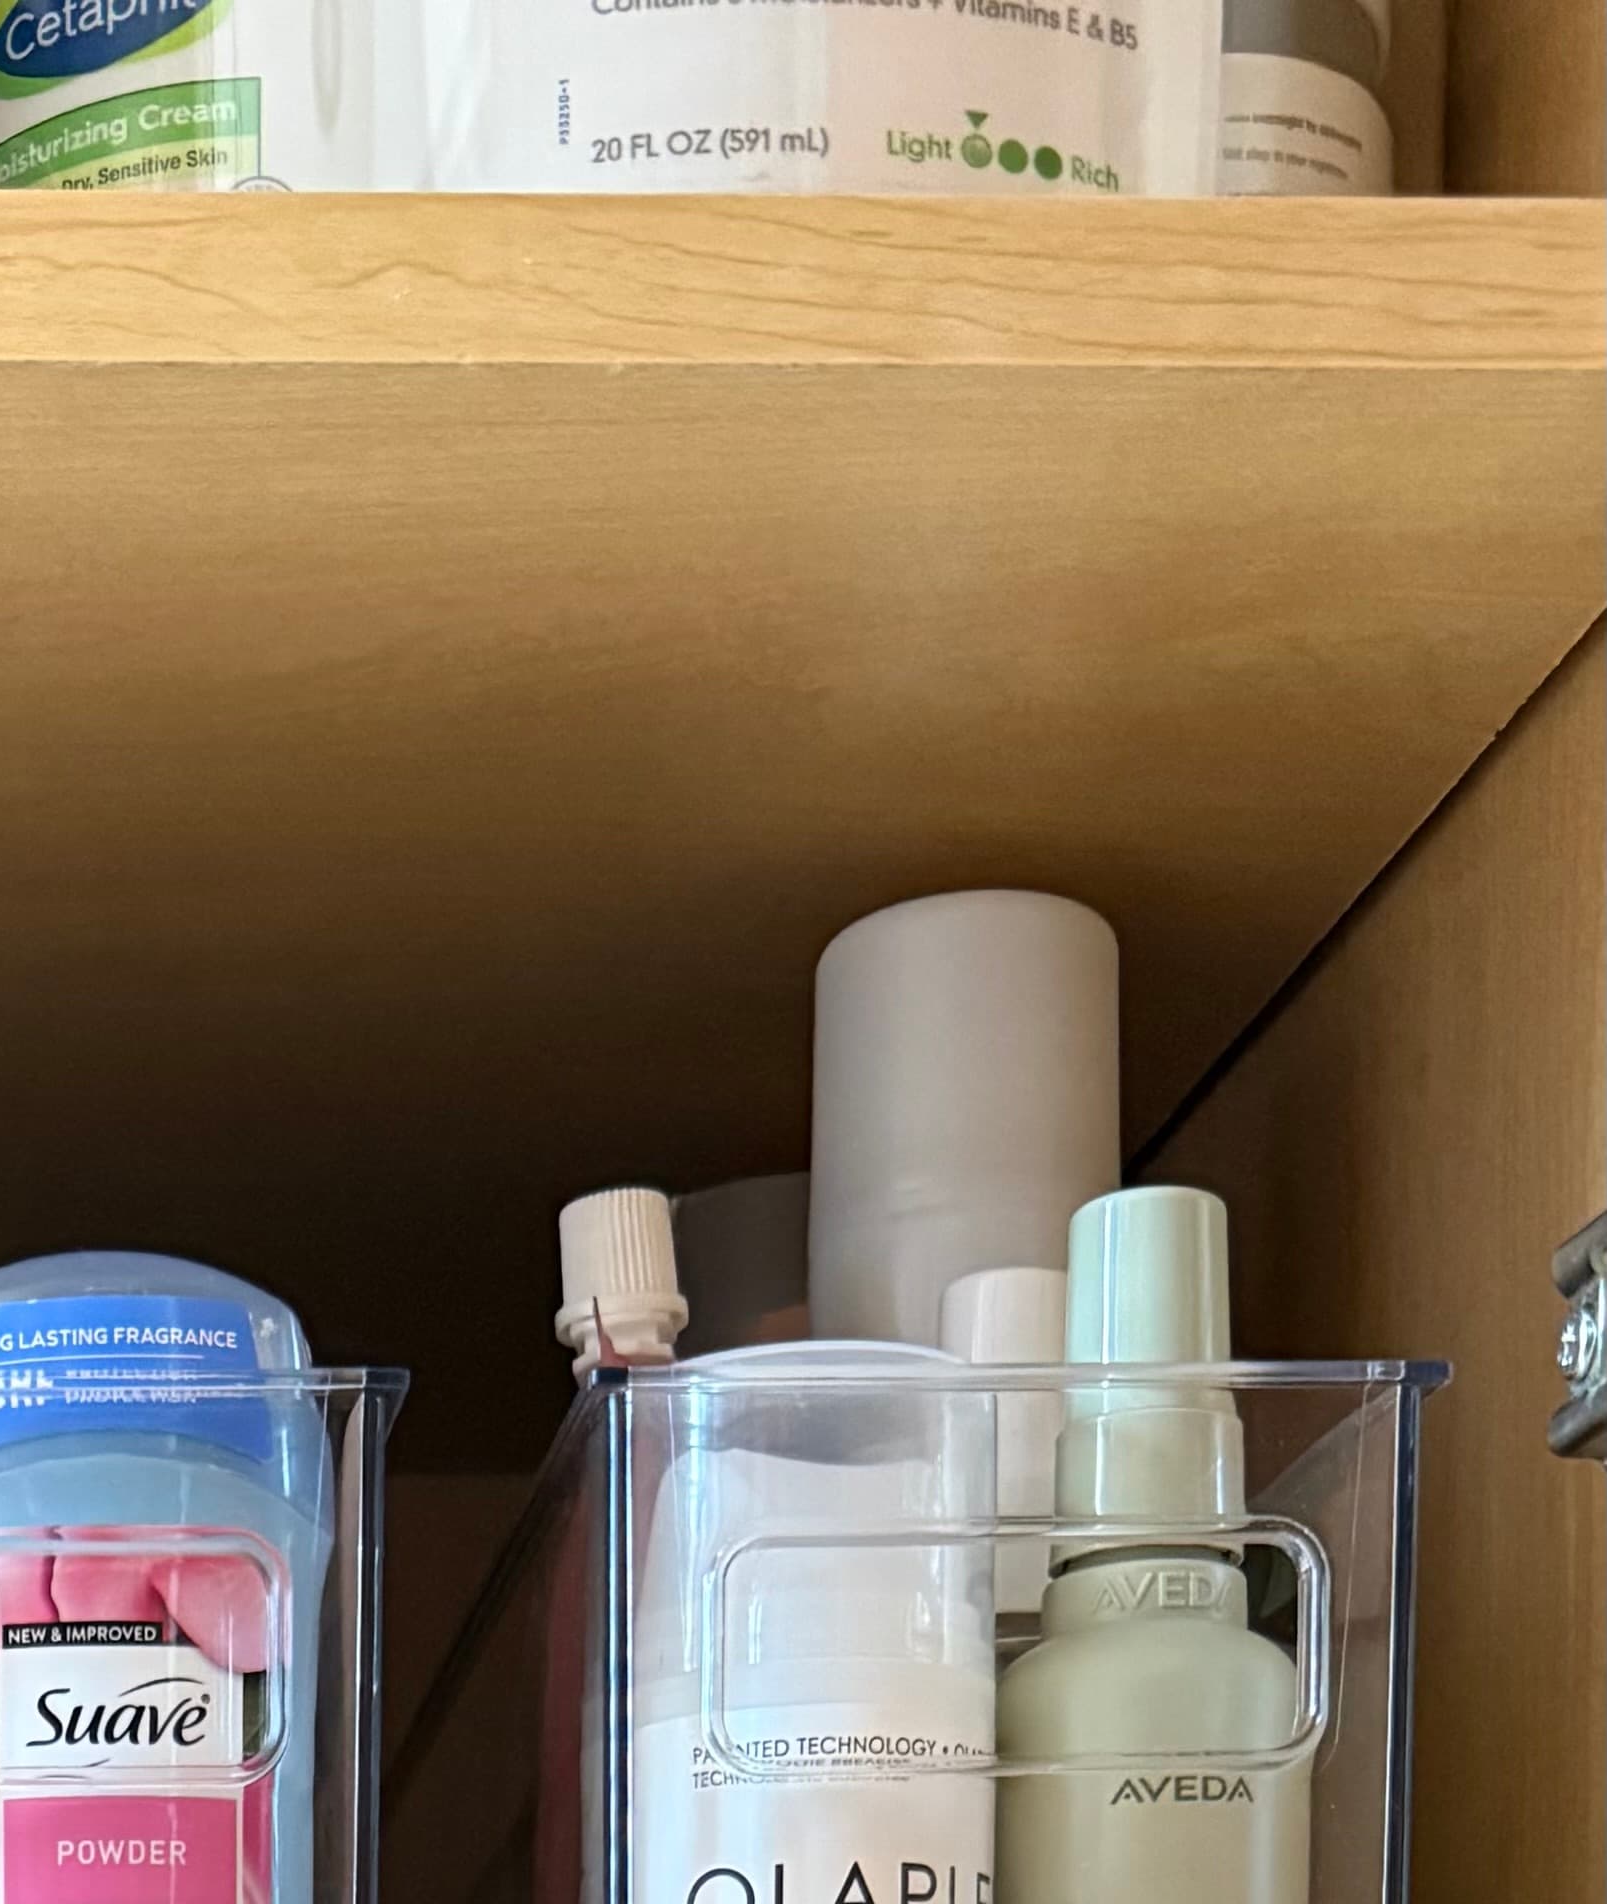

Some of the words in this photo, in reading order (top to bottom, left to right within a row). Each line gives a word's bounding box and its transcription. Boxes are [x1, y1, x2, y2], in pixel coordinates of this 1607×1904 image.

[5, 0, 196, 61] Cetap
[1068, 11, 1081, 36] E
[1087, 14, 1105, 44] &
[1110, 19, 1139, 51] B5
[139, 100, 236, 132] Cream
[591, 139, 622, 163] 20
[630, 133, 658, 159] FL
[667, 129, 712, 156] OZ
[720, 128, 771, 159] (591
[780, 129, 829, 158] mL)
[886, 131, 952, 163] Light
[99, 156, 181, 186] Sensitive
[186, 147, 228, 169] Skin
[1071, 157, 1120, 192] Rich
[18, 1328, 107, 1350] LASTING
[114, 1327, 238, 1349] FRAGRANCE
[8, 1628, 46, 1645] NEW
[51, 1627, 63, 1644] &
[66, 1625, 157, 1643] IMPROVED
[26, 1682, 212, 1748] Suave
[693, 1739, 789, 1765] PANTED
[797, 1736, 937, 1758] TECHNOLOGY
[1110, 1775, 1255, 1806] AVEDA
[55, 1839, 188, 1866] POWDER
